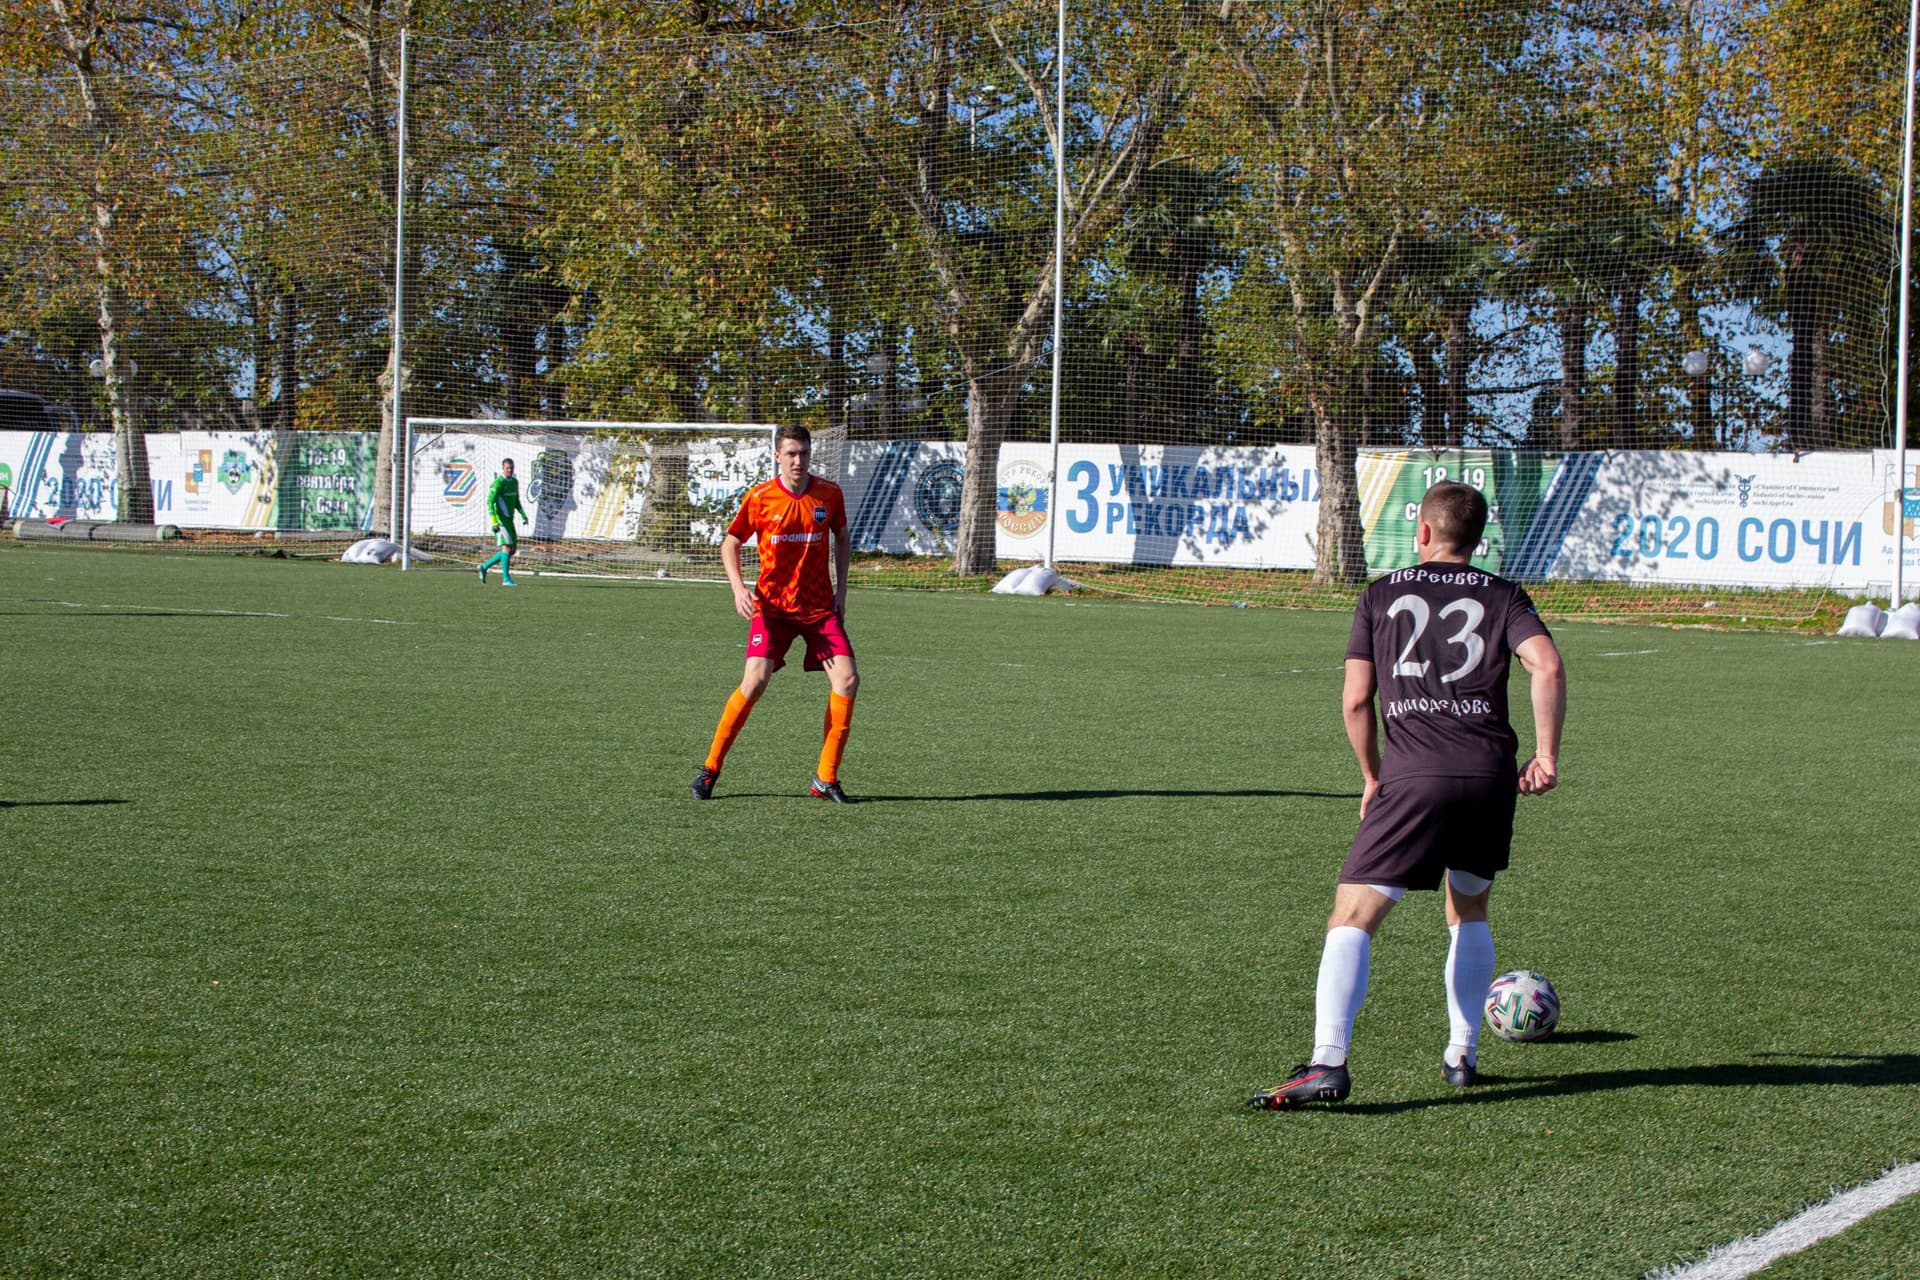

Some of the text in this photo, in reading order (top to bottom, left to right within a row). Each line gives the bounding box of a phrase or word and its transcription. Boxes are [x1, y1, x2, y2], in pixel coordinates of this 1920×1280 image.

[1066, 460, 1100, 533] 3
[1106, 502, 1251, 545] РЕКОРДА
[1610, 513, 1862, 566] 2020 СОЧИ
[1388, 568, 1493, 587] ПЕРЕСВЕТ
[1387, 594, 1485, 684] 23
